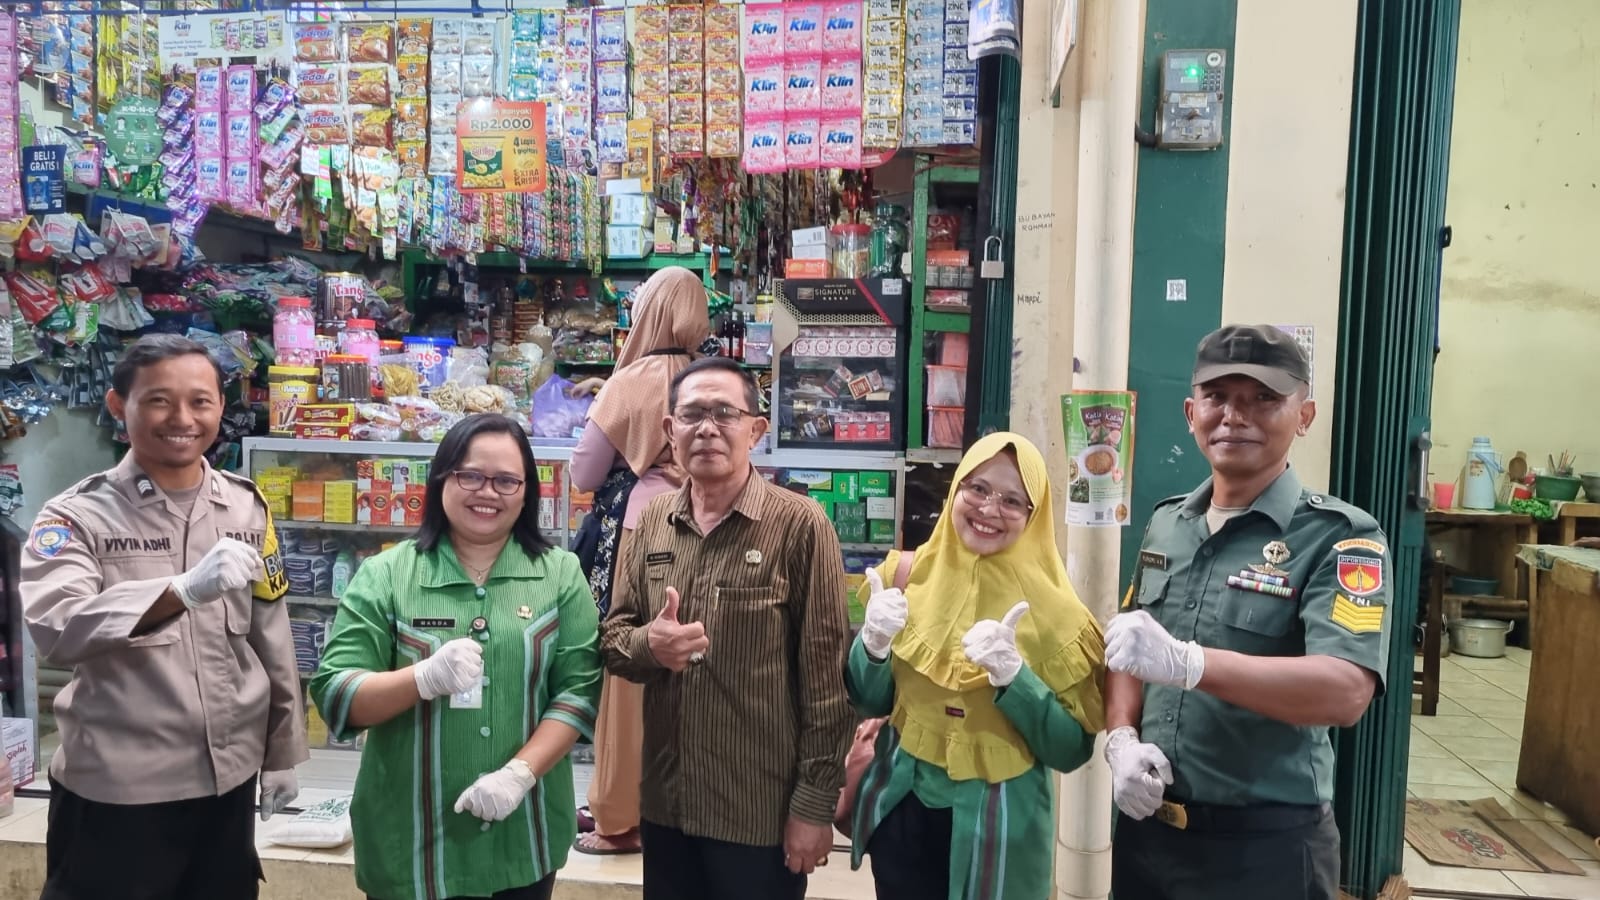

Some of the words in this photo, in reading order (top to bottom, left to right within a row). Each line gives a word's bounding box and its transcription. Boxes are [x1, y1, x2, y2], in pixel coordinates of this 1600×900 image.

[948, 3, 964, 11] ZINC
[752, 23, 777, 35] Klin
[790, 19, 816, 31] Klin
[827, 18, 854, 30] Klin
[947, 28, 964, 36] ZINC
[568, 39, 585, 47] Klin
[600, 37, 620, 46] Klin
[871, 49, 887, 57] ZINC
[947, 52, 963, 60] ZINC
[200, 75, 217, 83] Klin
[826, 76, 853, 87] Klin
[946, 77, 962, 85] ZINC
[751, 80, 777, 92] Klin
[601, 88, 621, 97] Klin
[200, 119, 217, 128] Klin
[470, 118, 531, 131] Rp2.000
[868, 121, 884, 129] ZINC
[944, 125, 960, 134] ZINC
[513, 137, 520, 147] 4
[752, 135, 777, 148] Klin
[787, 133, 812, 145] Klin
[826, 132, 853, 144] Klin
[602, 140, 622, 148] Klin
[33, 151, 50, 161] BELI
[30, 161, 56, 172] GRATIS
[73, 161, 94, 169] Klin
[200, 164, 218, 174] Klin
[334, 284, 365, 302] Tang
[814, 288, 857, 296] SIGNATURE
[143, 537, 171, 552] ADHI
[1348, 594, 1371, 607] TNI
